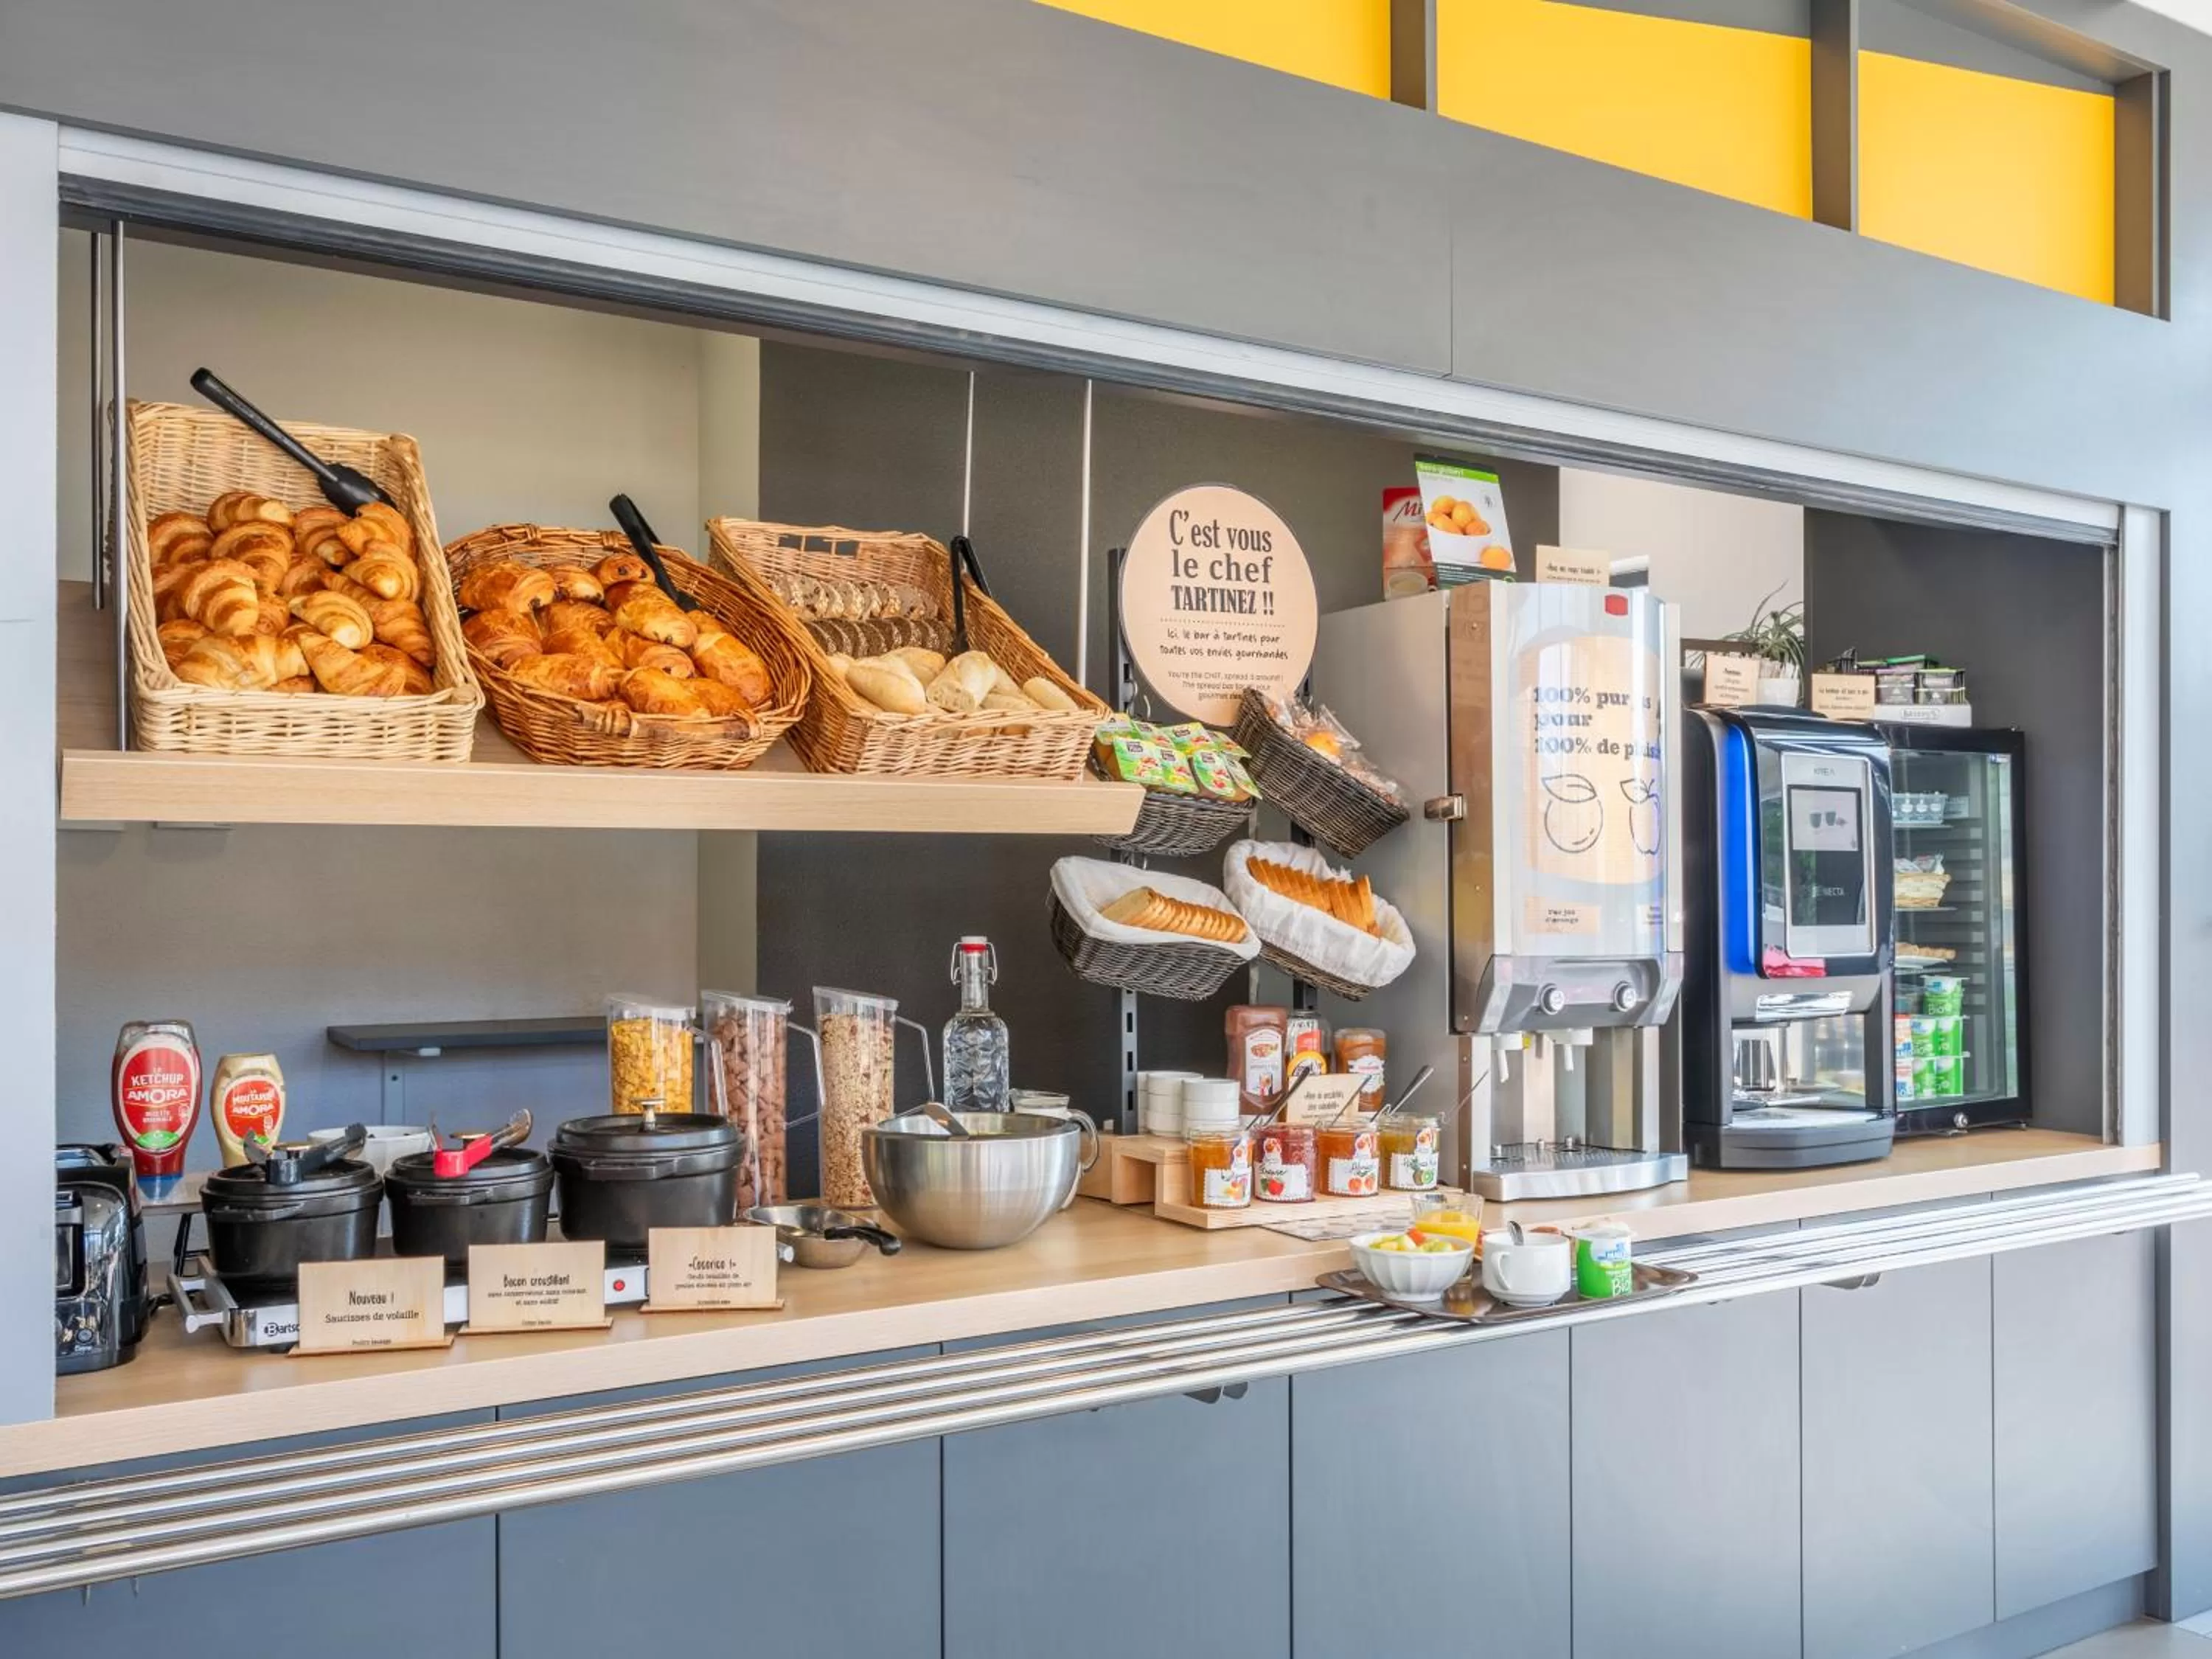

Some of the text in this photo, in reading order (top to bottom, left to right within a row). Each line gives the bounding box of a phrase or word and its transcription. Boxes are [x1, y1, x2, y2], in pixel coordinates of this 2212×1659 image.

[1169, 509, 1273, 553] C'est vous
[1171, 549, 1273, 584] le chef
[1170, 585, 1275, 616] TARTINEZ !!
[1183, 629, 1191, 640] le
[1194, 630, 1210, 641] bar
[1213, 628, 1220, 641] à
[1222, 630, 1258, 643] tartines
[1260, 634, 1281, 647] pour
[1189, 647, 1204, 657] vos
[1207, 647, 1233, 658] envies
[1235, 648, 1289, 661] gourmandes
[1534, 686, 1590, 704] 100%
[1596, 692, 1630, 709] pur
[1534, 713, 1593, 731] pour
[1534, 737, 1591, 754] 100%
[1596, 738, 1620, 754] de
[131, 1073, 184, 1087] KETCHUP
[127, 1088, 188, 1105] AMORA
[232, 1102, 275, 1116] AMORA
[504, 1273, 527, 1288] Bacon
[349, 1290, 387, 1306] Nouveau
[324, 1309, 420, 1324] Saucisses de volaille
